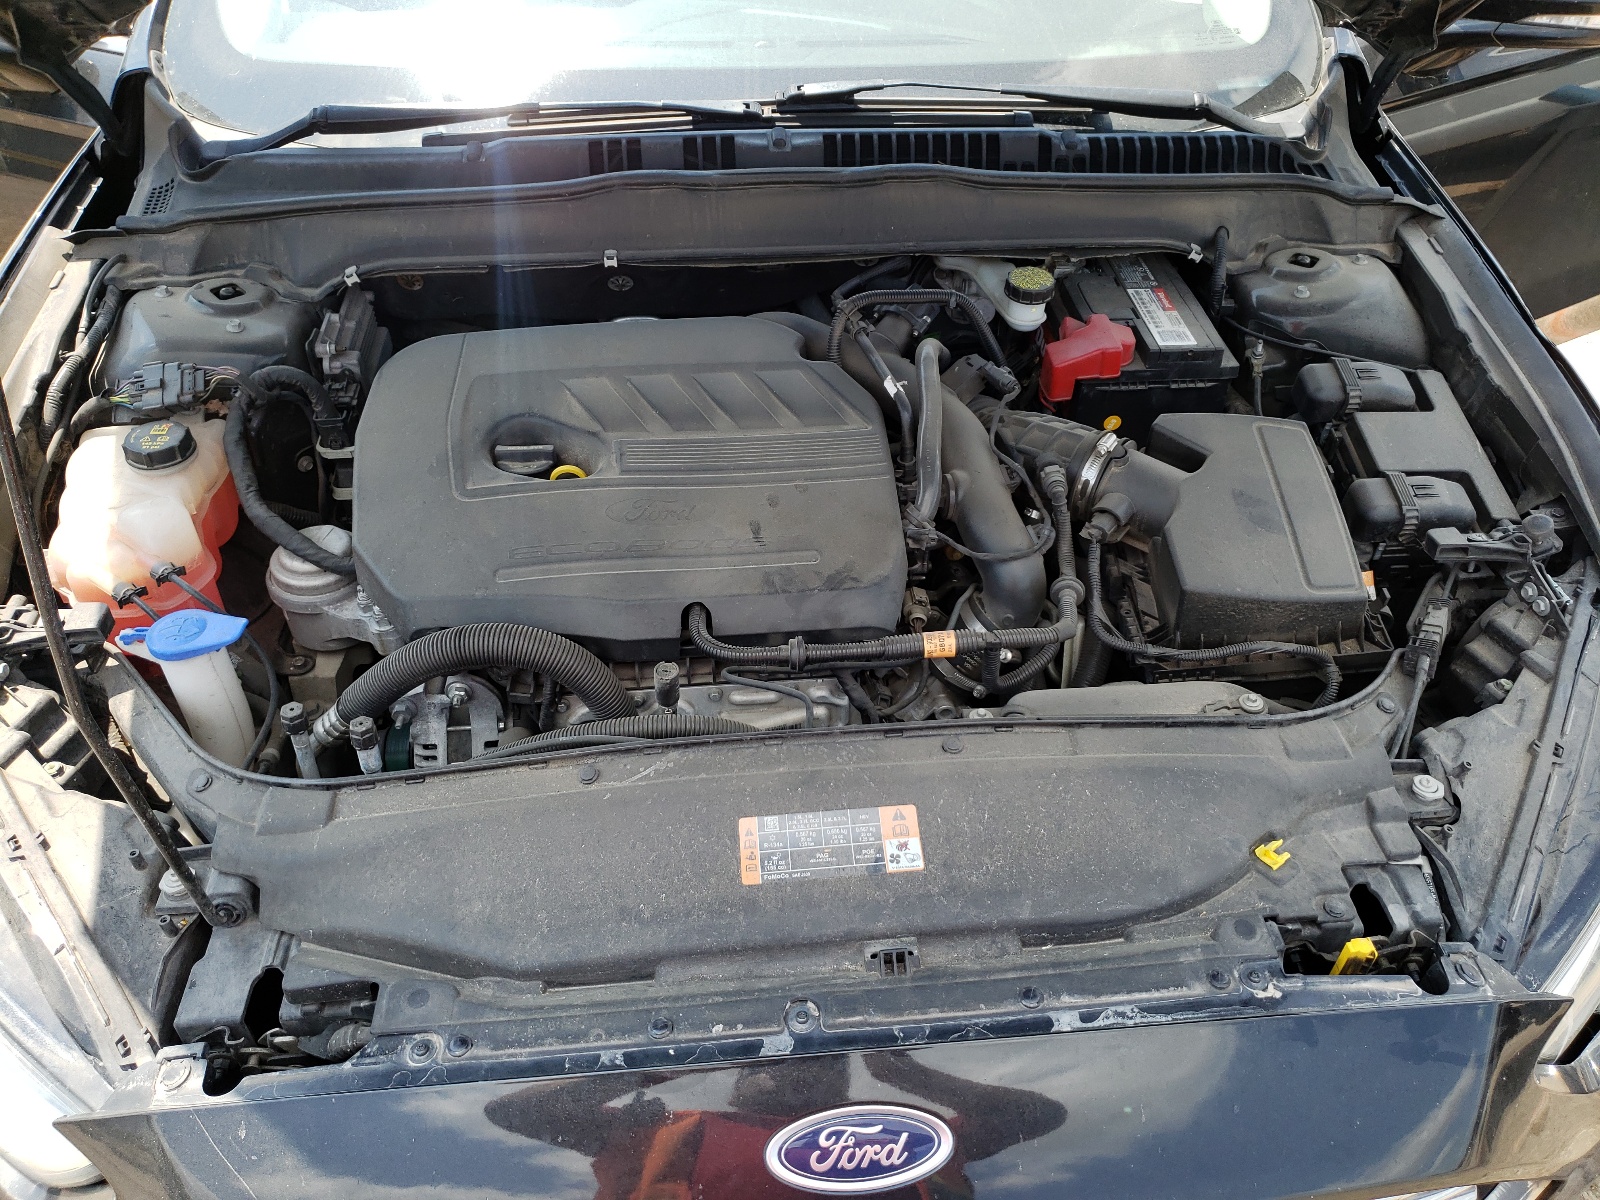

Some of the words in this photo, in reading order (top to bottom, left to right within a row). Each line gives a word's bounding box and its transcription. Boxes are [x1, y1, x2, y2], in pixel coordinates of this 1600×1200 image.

[624, 498, 696, 523] Ford
[508, 535, 800, 560] ECOBOOS
[763, 872, 789, 880] FoMoCo
[809, 1125, 909, 1173] Ford
